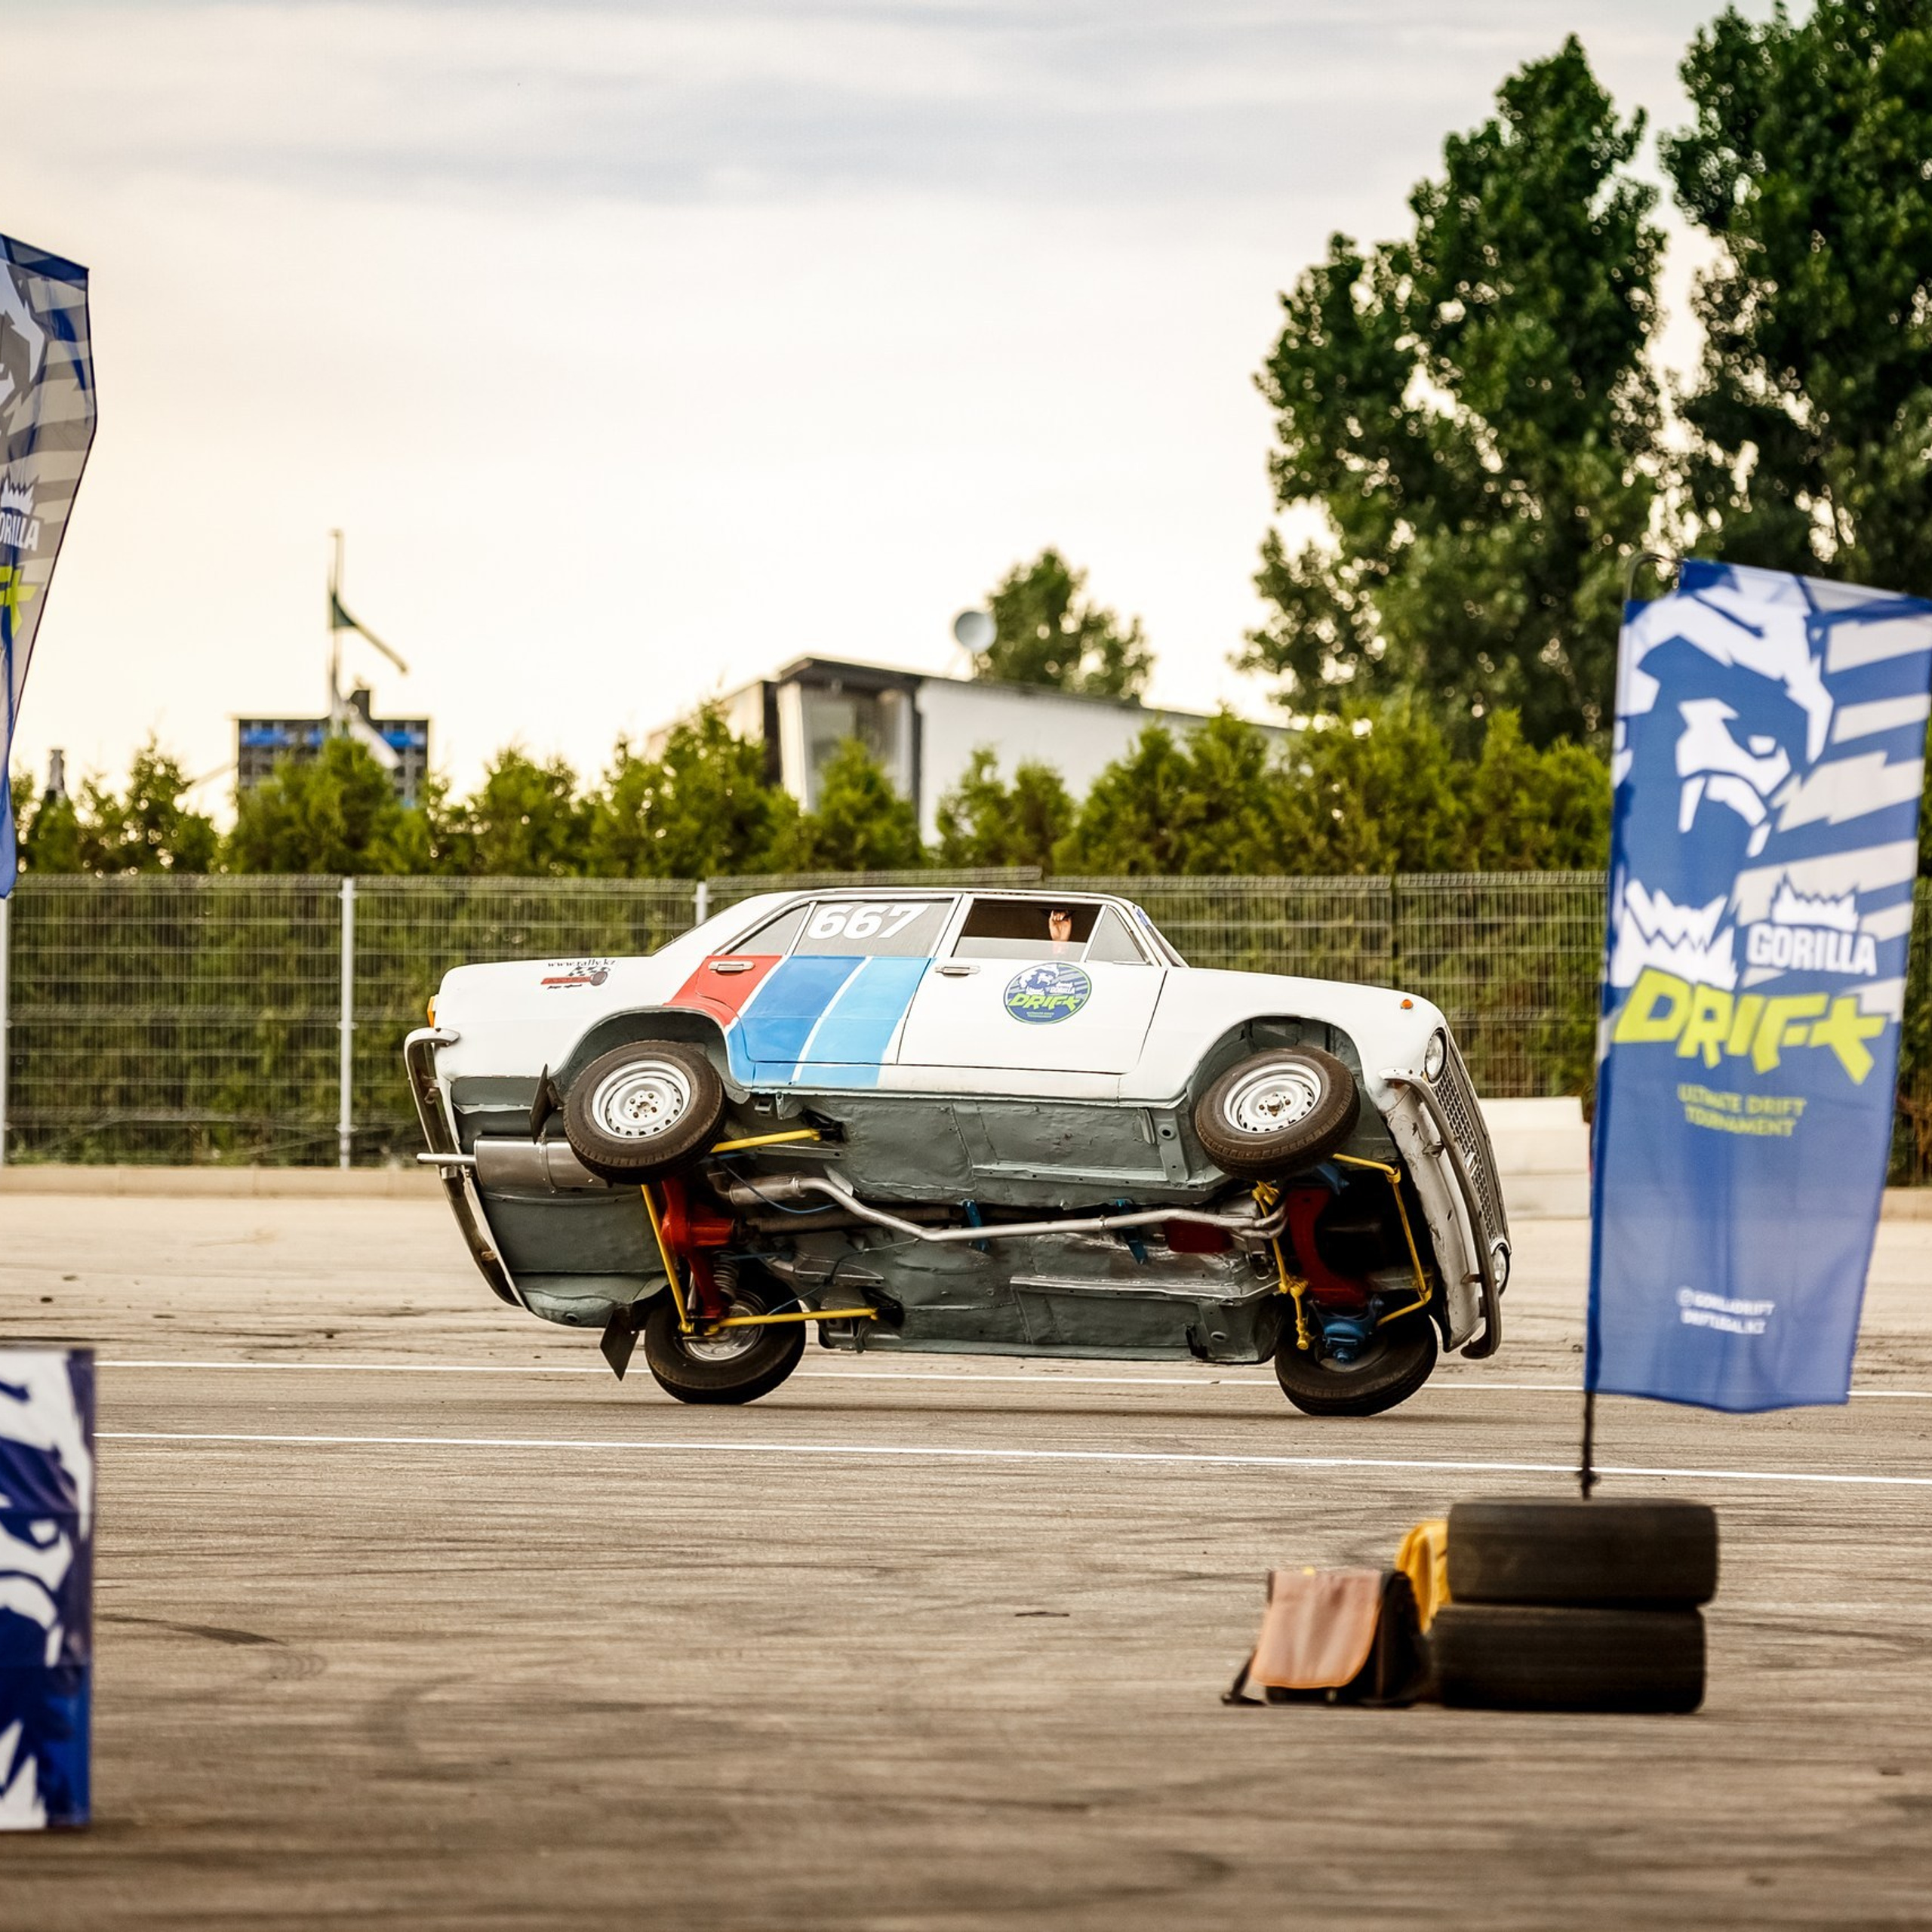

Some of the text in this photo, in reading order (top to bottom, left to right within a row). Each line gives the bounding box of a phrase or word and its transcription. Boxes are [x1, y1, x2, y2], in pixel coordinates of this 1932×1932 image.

[0, 512, 40, 552] ORILLA
[807, 904, 931, 940] 667
[1746, 922, 1878, 976] GORILLA
[1008, 993, 1080, 1011] DRIFT
[1613, 968, 1887, 1084] DRIFT
[1746, 1094, 1807, 1117] DRIFT
